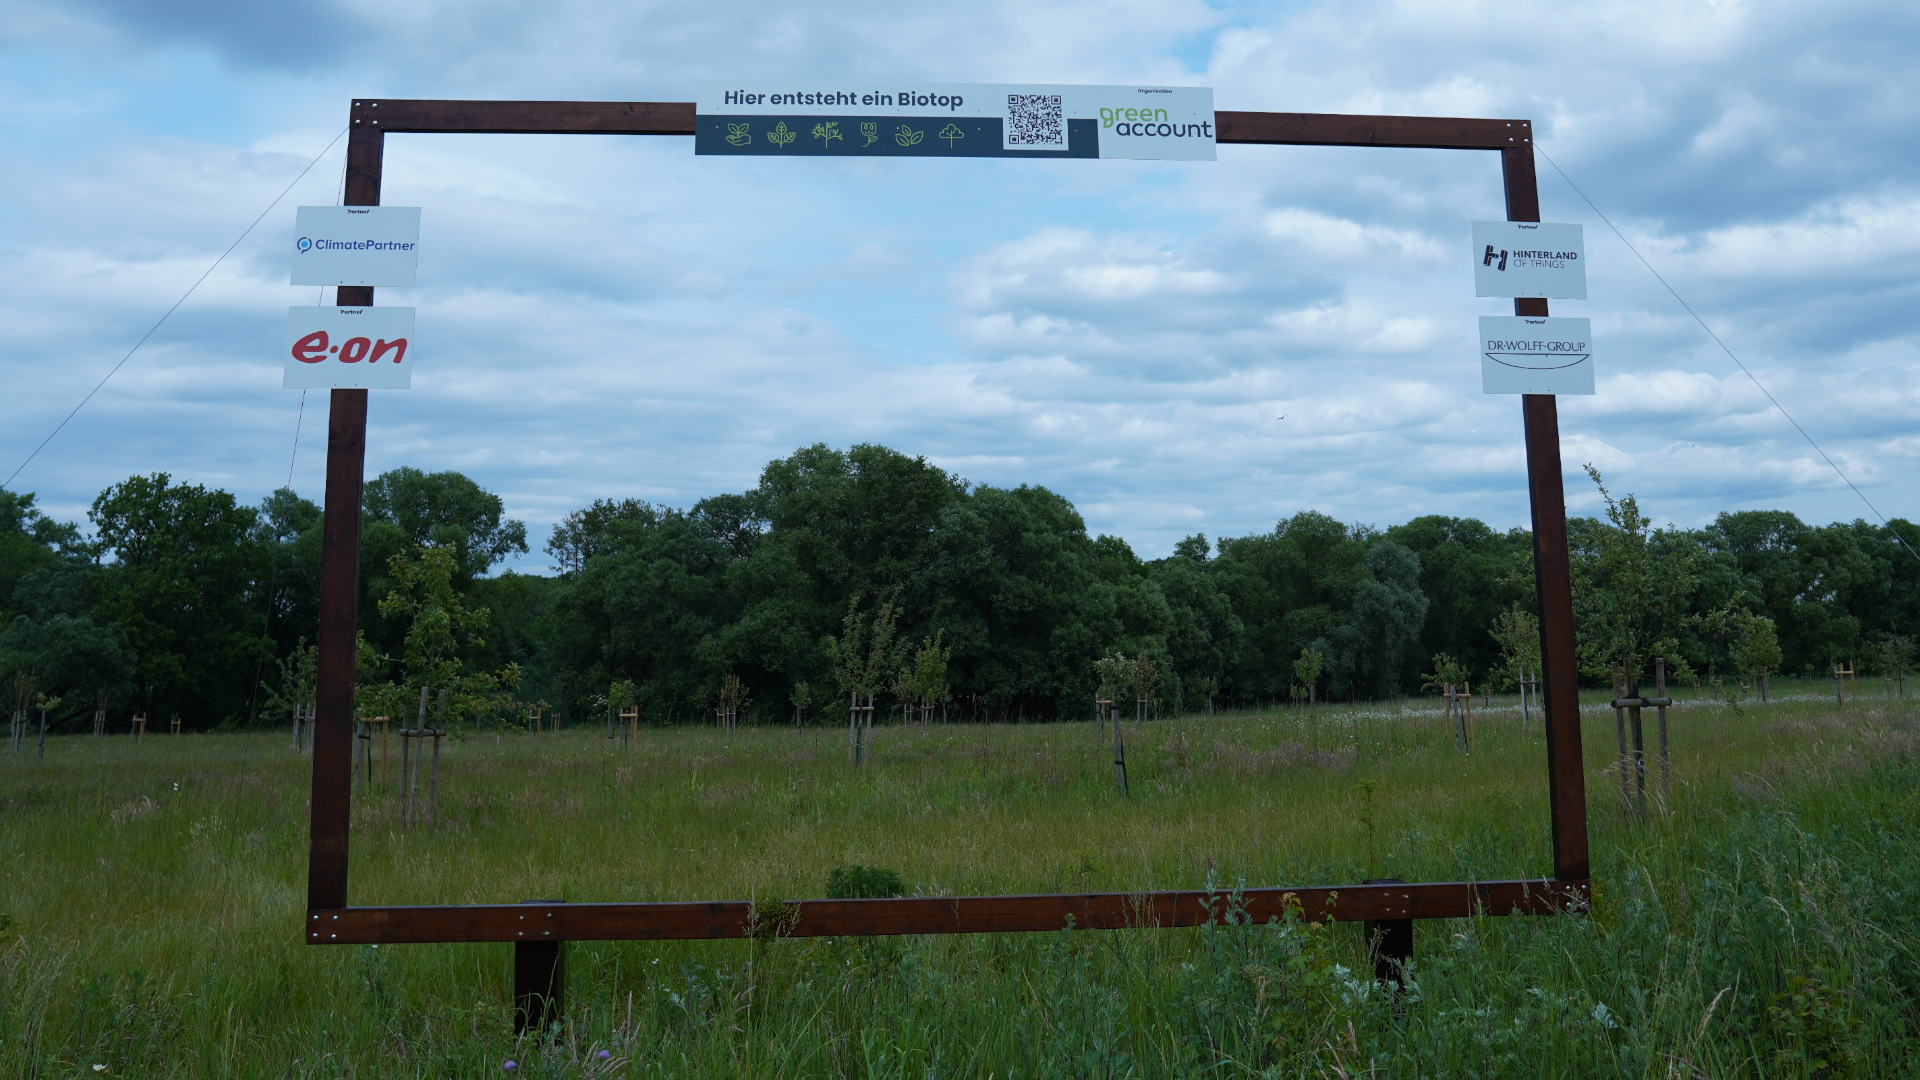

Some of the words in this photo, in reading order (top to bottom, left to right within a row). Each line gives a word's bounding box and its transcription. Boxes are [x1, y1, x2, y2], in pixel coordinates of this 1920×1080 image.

[724, 90, 764, 105] Hier
[770, 91, 857, 106] entsteht
[861, 91, 893, 106] ein
[898, 92, 964, 111] Biotop
[1099, 107, 1168, 128] green
[1116, 120, 1213, 138] account
[315, 239, 415, 251] ClimatePartner
[1513, 250, 1578, 260] HINTERLAND
[1513, 259, 1527, 268] OF
[1530, 260, 1565, 269] THINGS
